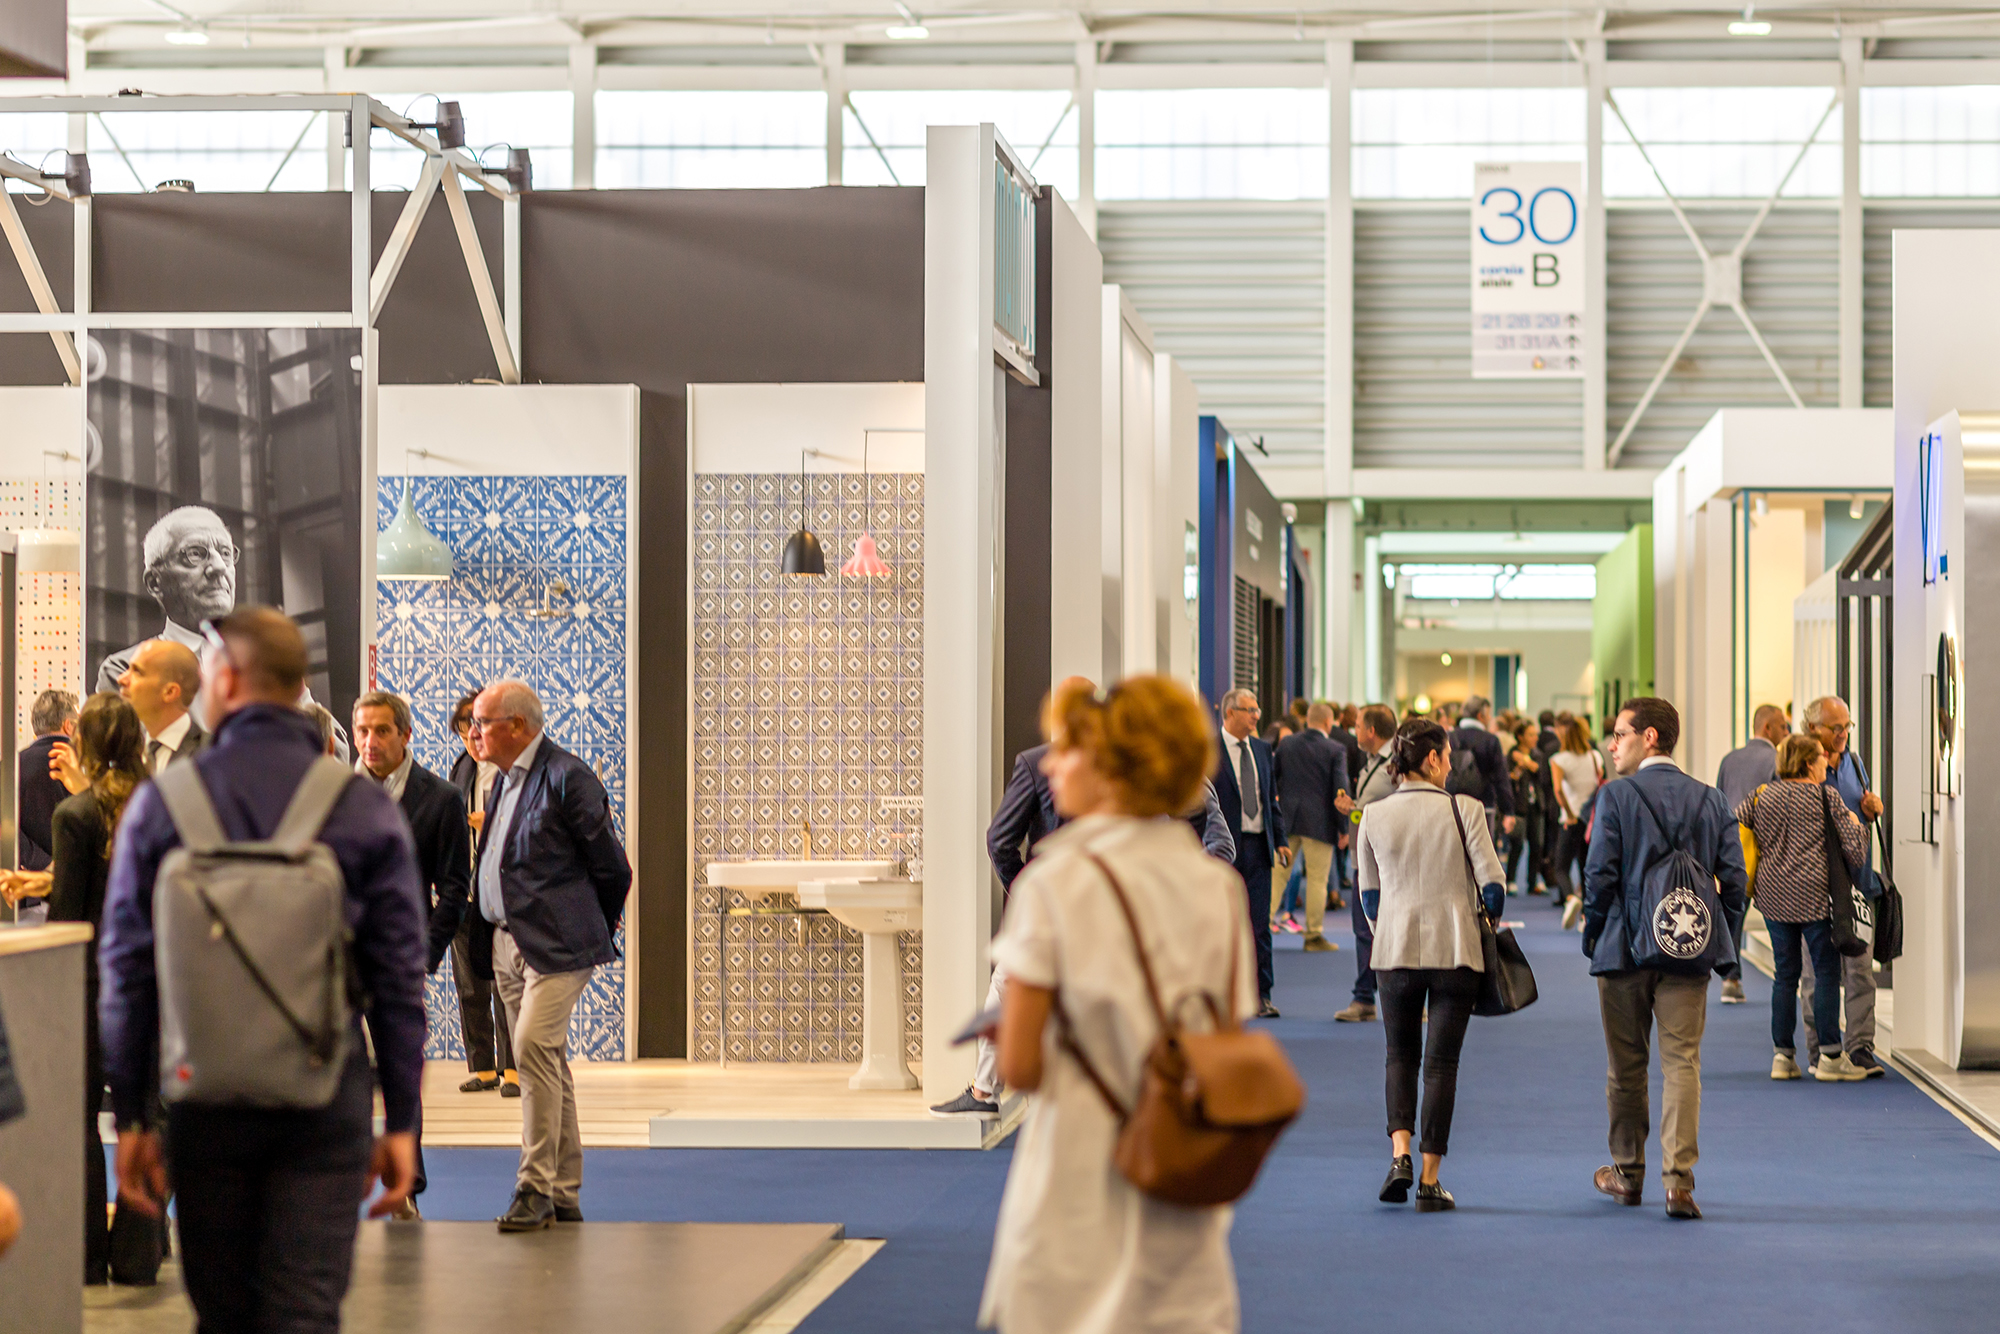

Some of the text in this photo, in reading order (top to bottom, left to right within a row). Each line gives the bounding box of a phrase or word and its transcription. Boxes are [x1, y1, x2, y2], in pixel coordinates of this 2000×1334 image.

[1479, 186, 1578, 245] 30
[1480, 264, 1524, 275] corsia
[1532, 252, 1560, 287] B
[1481, 314, 1501, 329] 21
[884, 798, 923, 806] SPARTACO
